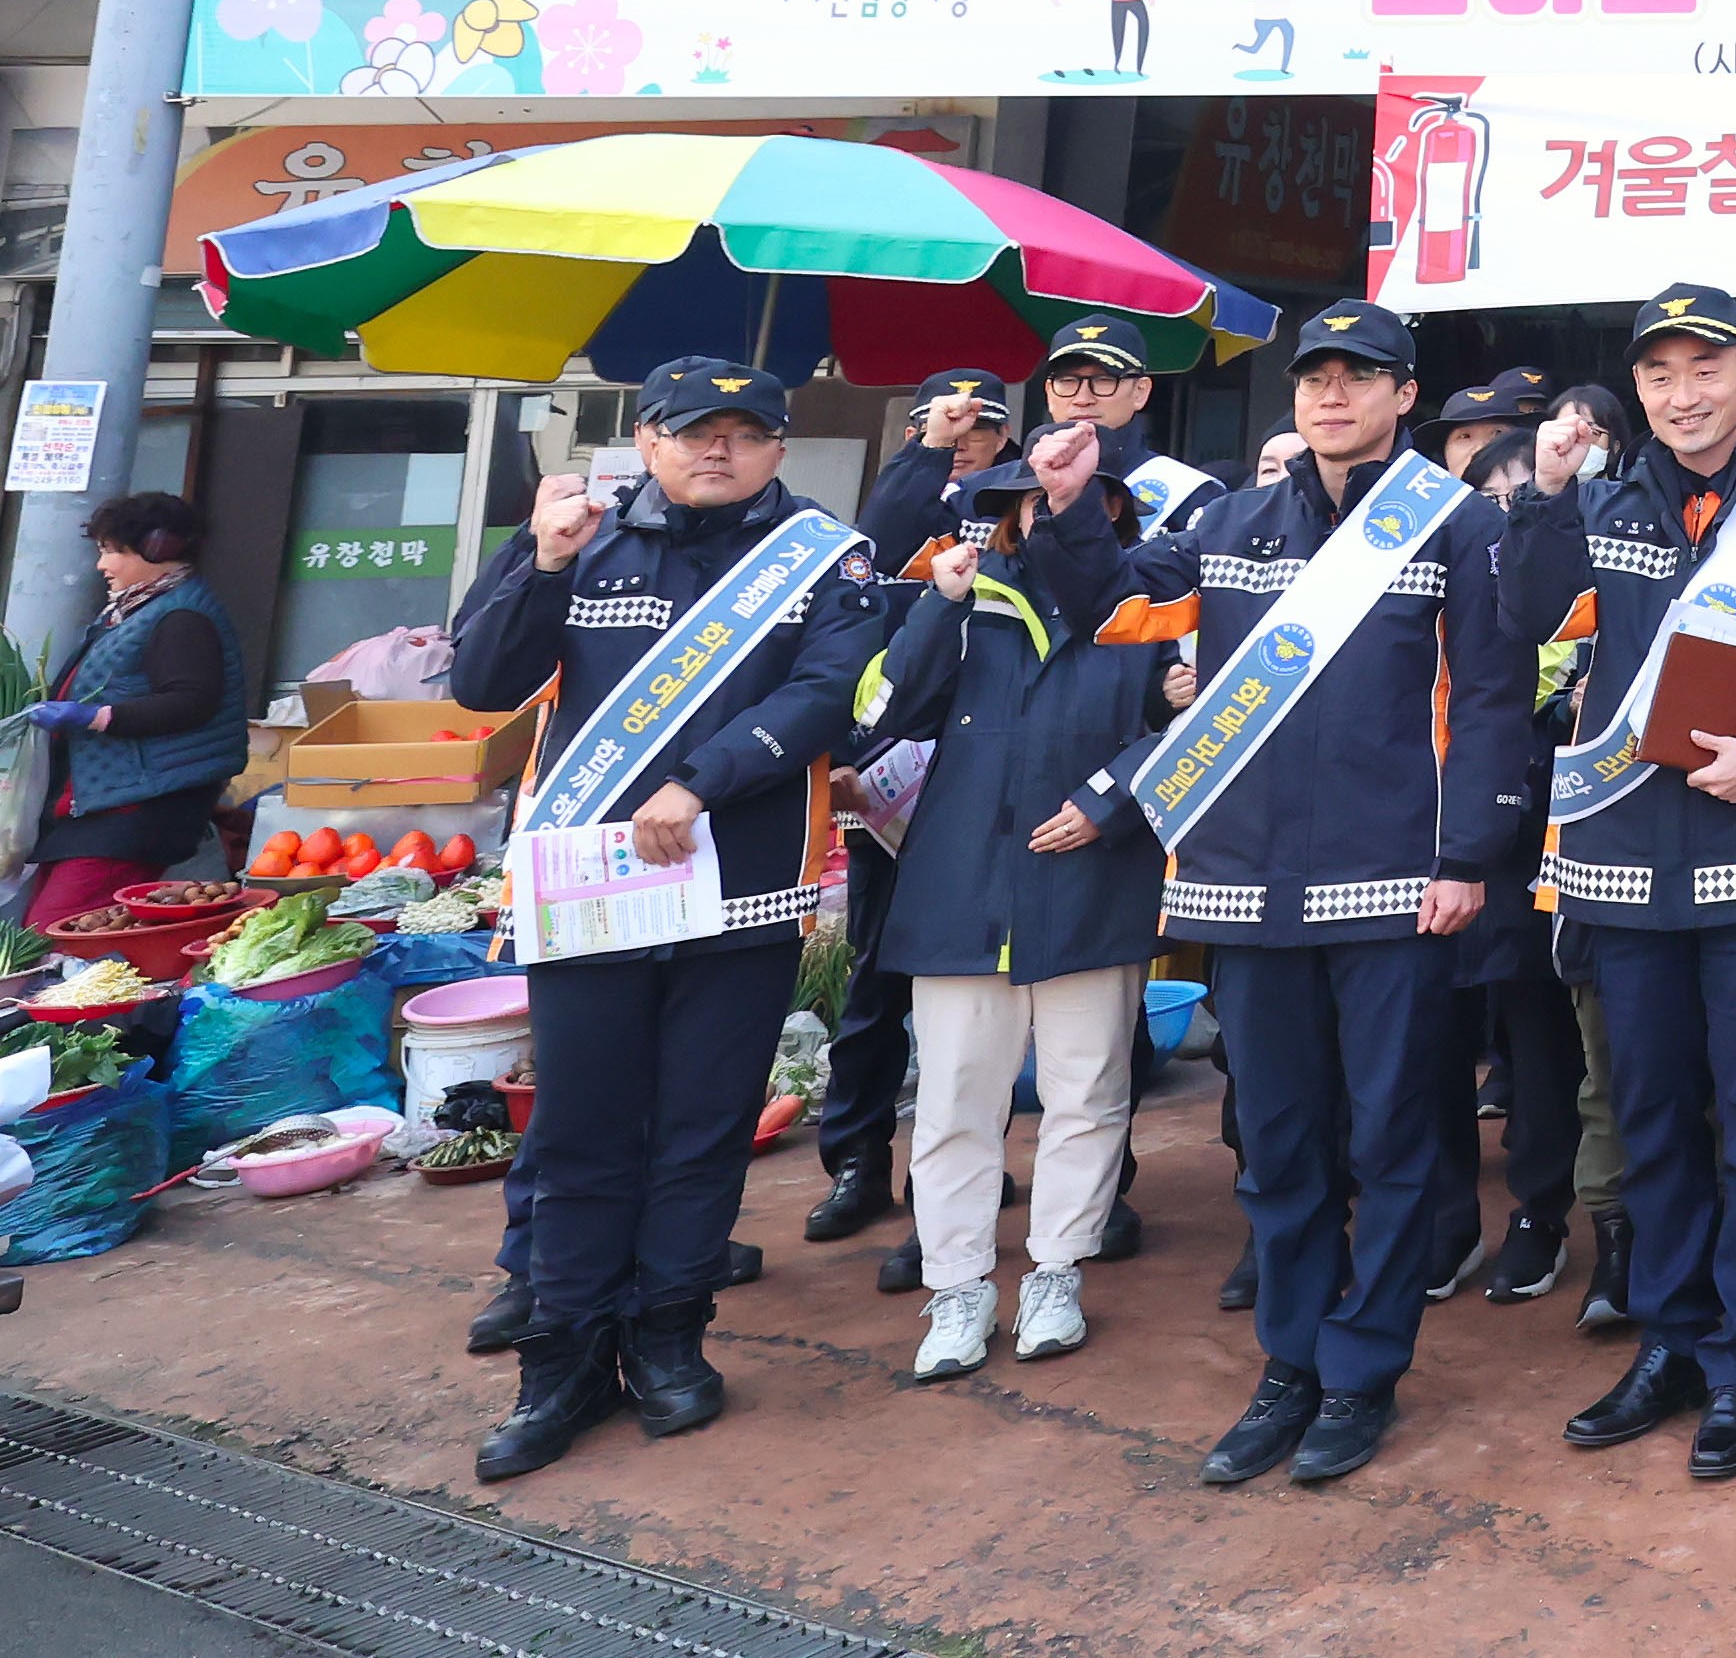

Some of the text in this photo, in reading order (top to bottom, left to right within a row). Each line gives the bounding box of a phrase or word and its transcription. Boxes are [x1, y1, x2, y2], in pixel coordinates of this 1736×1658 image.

[302, 539, 430, 571] 유창천막
[730, 541, 817, 621] 겨울철
[621, 621, 736, 736] 화재예방
[751, 725, 785, 760] GORE-TEX
[1153, 677, 1272, 812] 화목보일러
